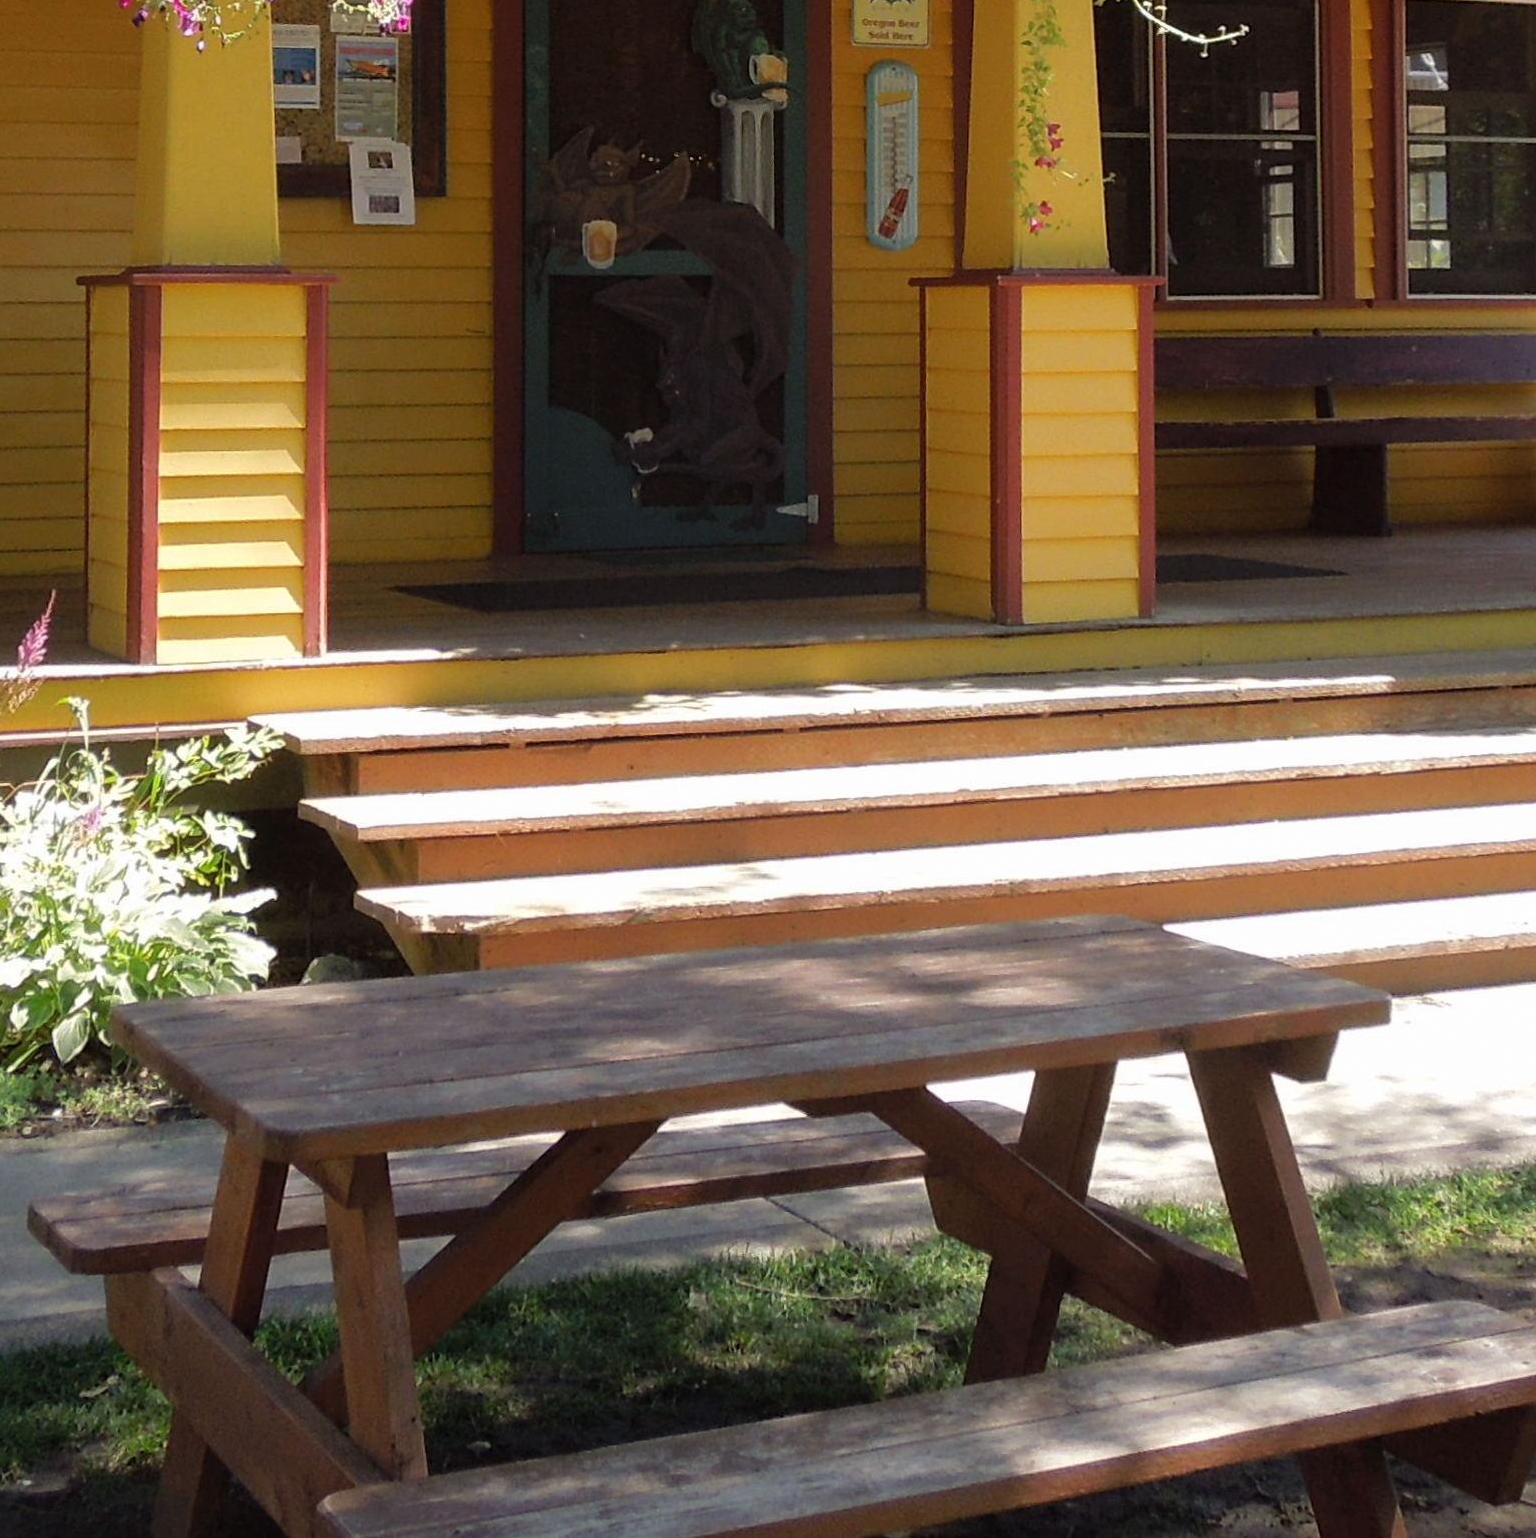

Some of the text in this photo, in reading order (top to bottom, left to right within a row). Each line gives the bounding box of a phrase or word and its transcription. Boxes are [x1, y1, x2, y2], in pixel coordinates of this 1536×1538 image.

[862, 19, 920, 29] Oregon Beer
[868, 31, 889, 40] Sold
